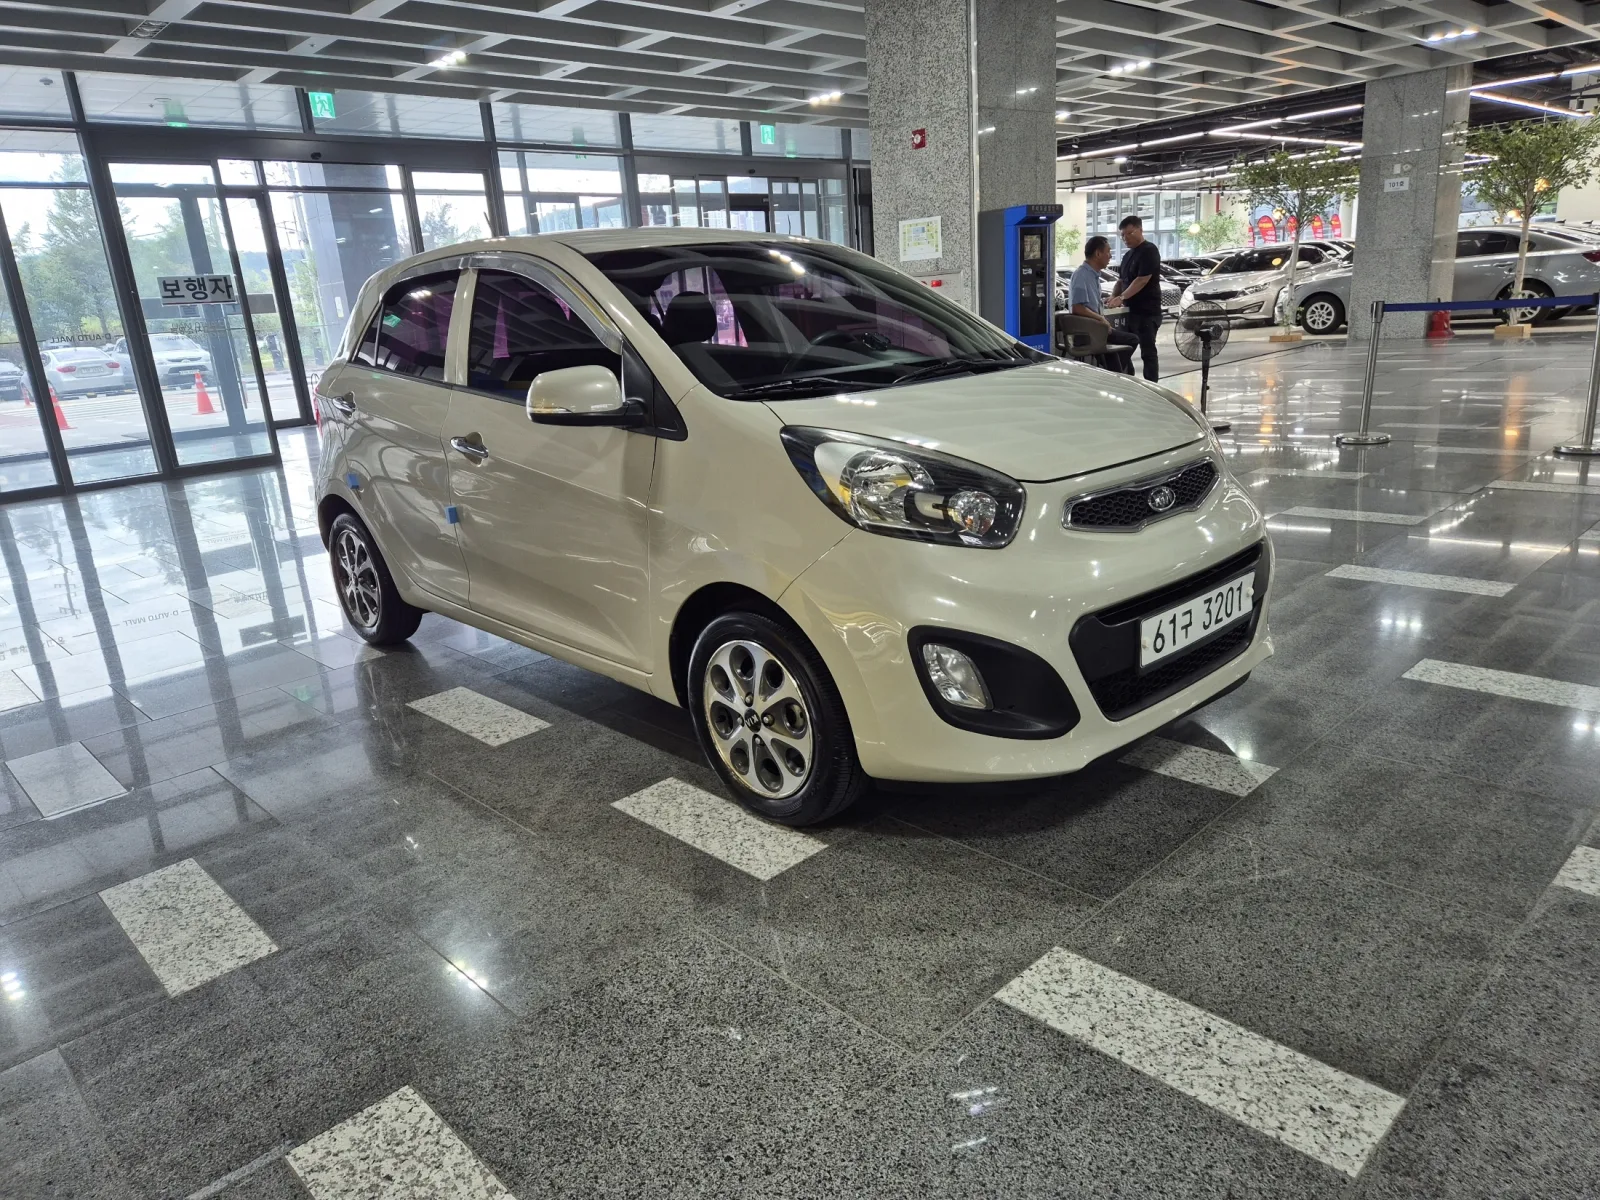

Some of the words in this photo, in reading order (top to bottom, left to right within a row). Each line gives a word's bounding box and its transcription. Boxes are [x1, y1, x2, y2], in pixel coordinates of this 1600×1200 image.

[162, 277, 233, 300] 보행자
[1153, 608, 1193, 653] 61구
[1202, 581, 1243, 630] 3201
